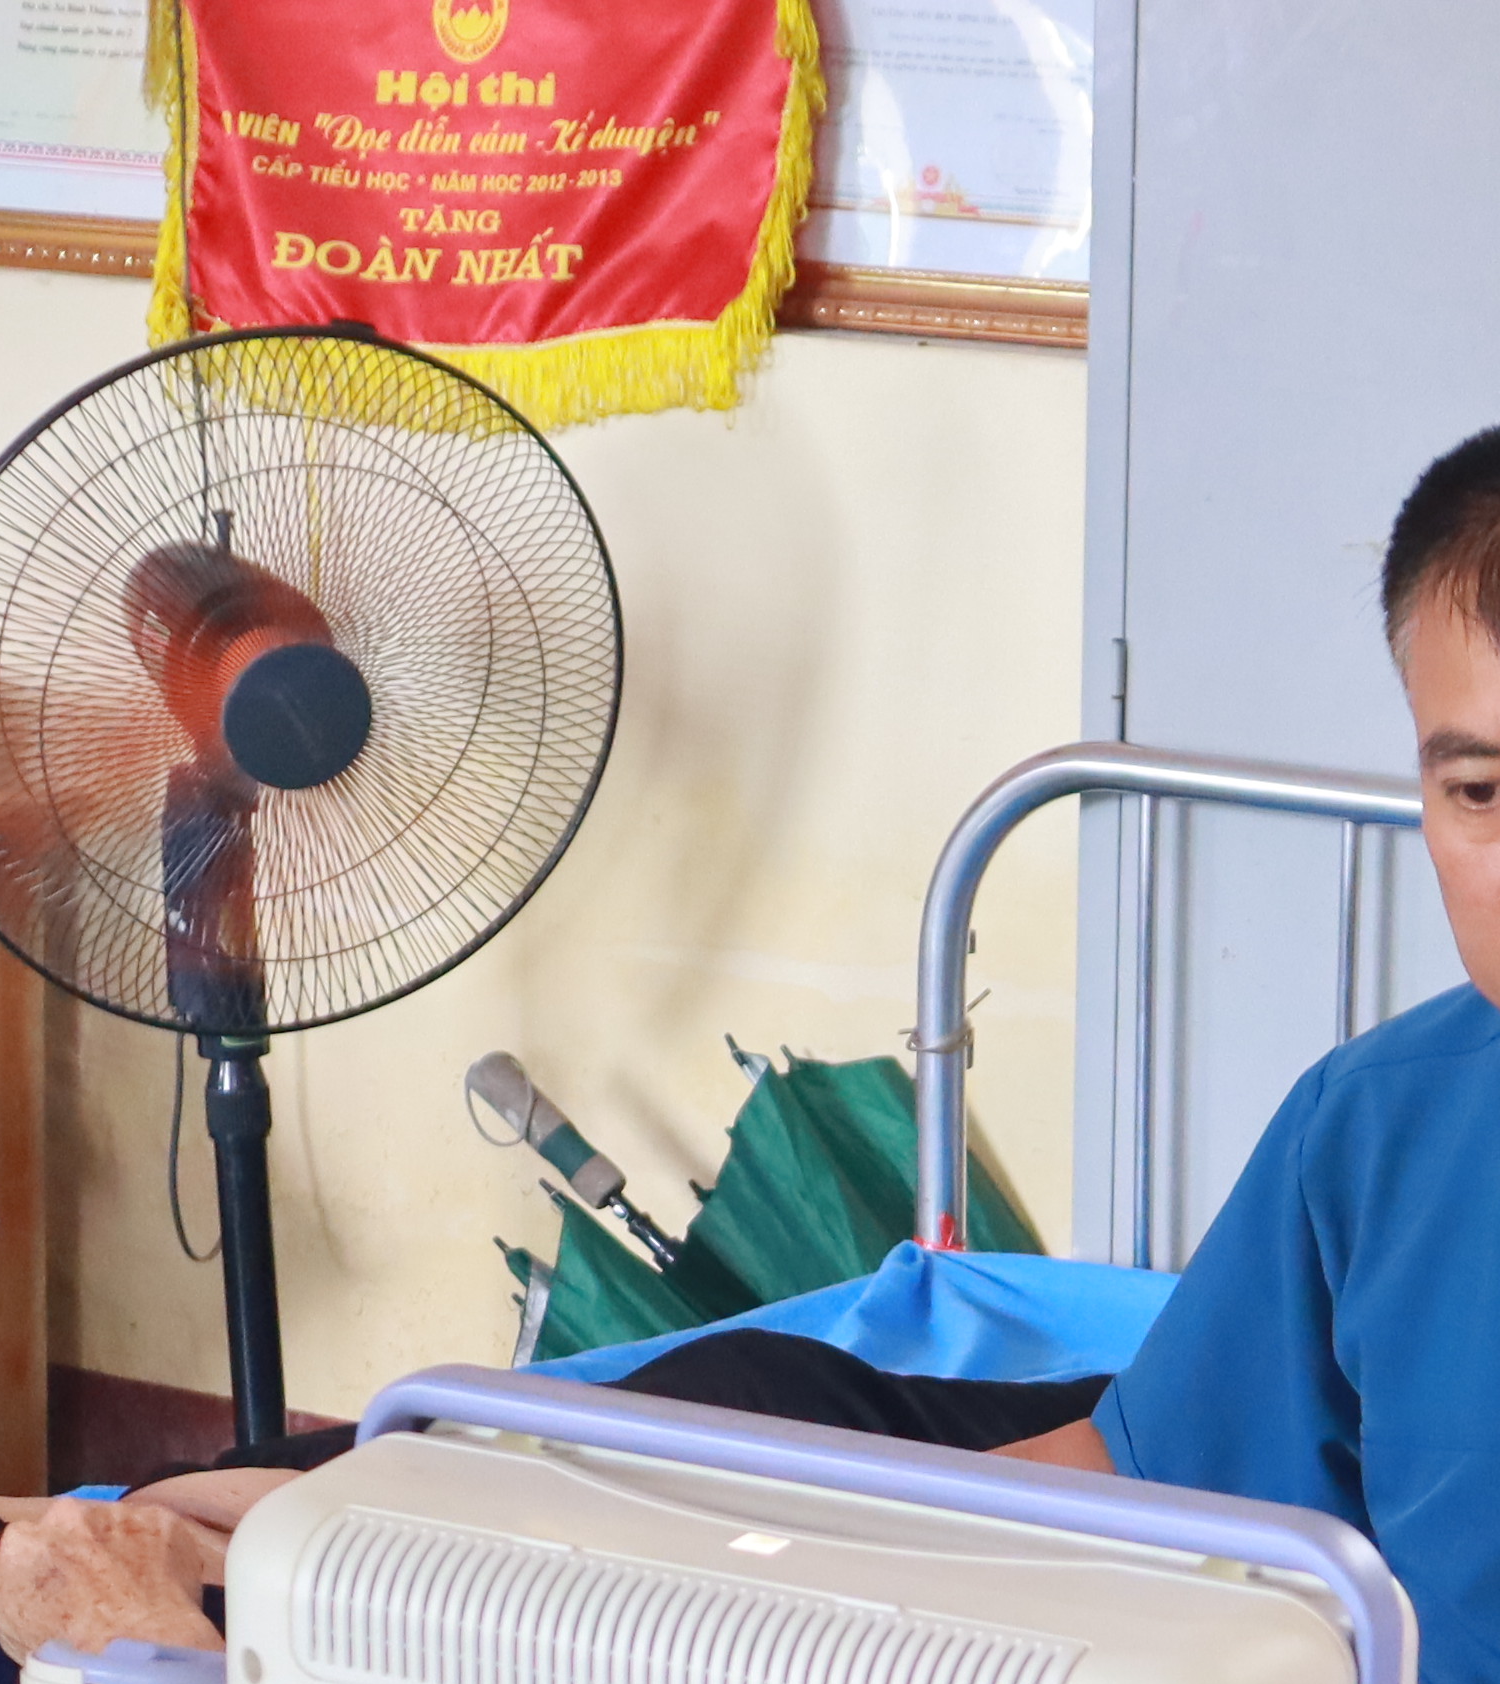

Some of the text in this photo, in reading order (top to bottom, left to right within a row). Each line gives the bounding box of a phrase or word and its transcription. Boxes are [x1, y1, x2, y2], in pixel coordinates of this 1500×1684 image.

[376, 70, 555, 110] Hội thi
[238, 110, 301, 146] VIÊN
[252, 153, 302, 178] CẤP
[309, 158, 360, 187] TIỂU
[366, 169, 409, 195] HỌC
[431, 170, 477, 192] NĂM
[482, 174, 522, 194] HỌC
[399, 207, 502, 237] TẶNG
[272, 227, 583, 285] ĐOÀN NHẤT
